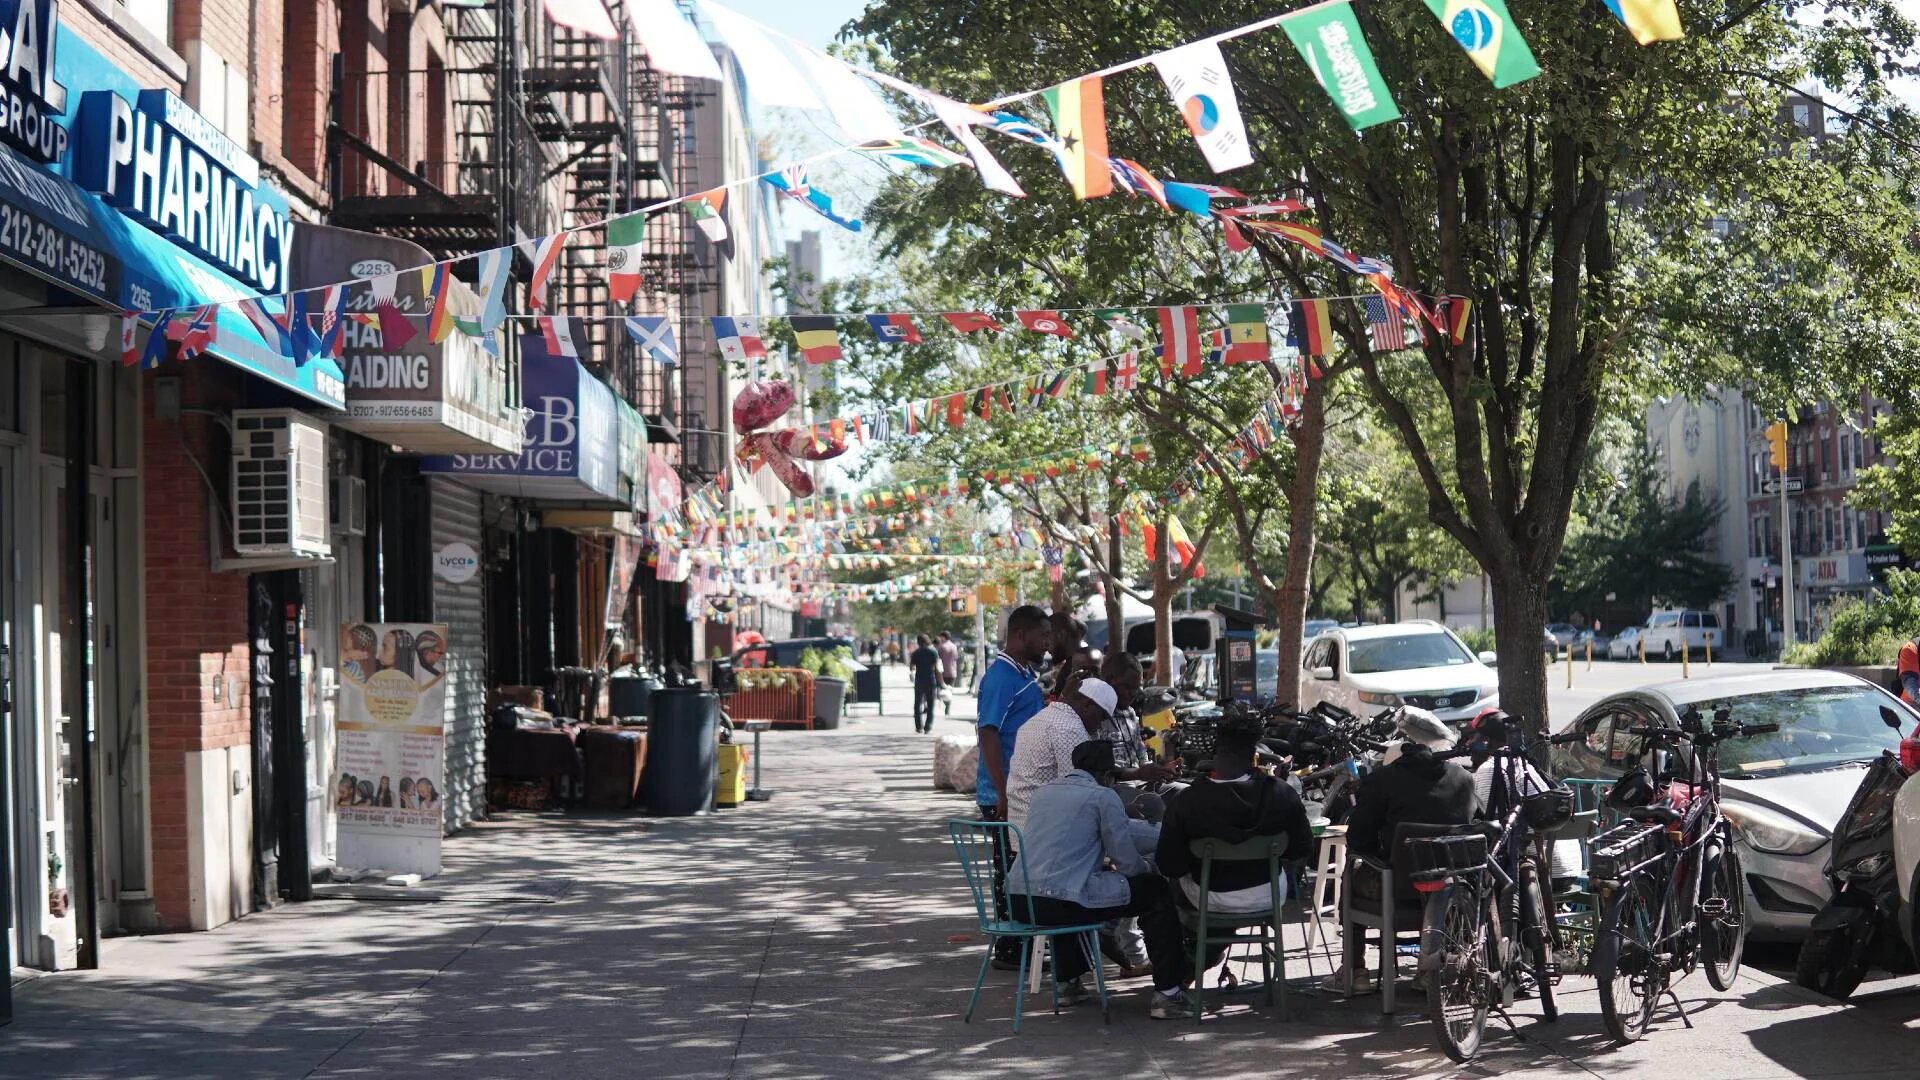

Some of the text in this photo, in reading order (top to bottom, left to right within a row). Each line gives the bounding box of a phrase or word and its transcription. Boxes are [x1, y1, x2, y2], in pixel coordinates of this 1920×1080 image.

[0, 0, 67, 115] AL
[108, 95, 294, 294] PHARMACY
[1, 205, 105, 292] 212-281-5252
[357, 263, 391, 275] 2253
[131, 283, 152, 311] 2255
[453, 448, 574, 472] SERVICE
[440, 556, 466, 566] Lyca
[1818, 560, 1837, 580] ATAX
